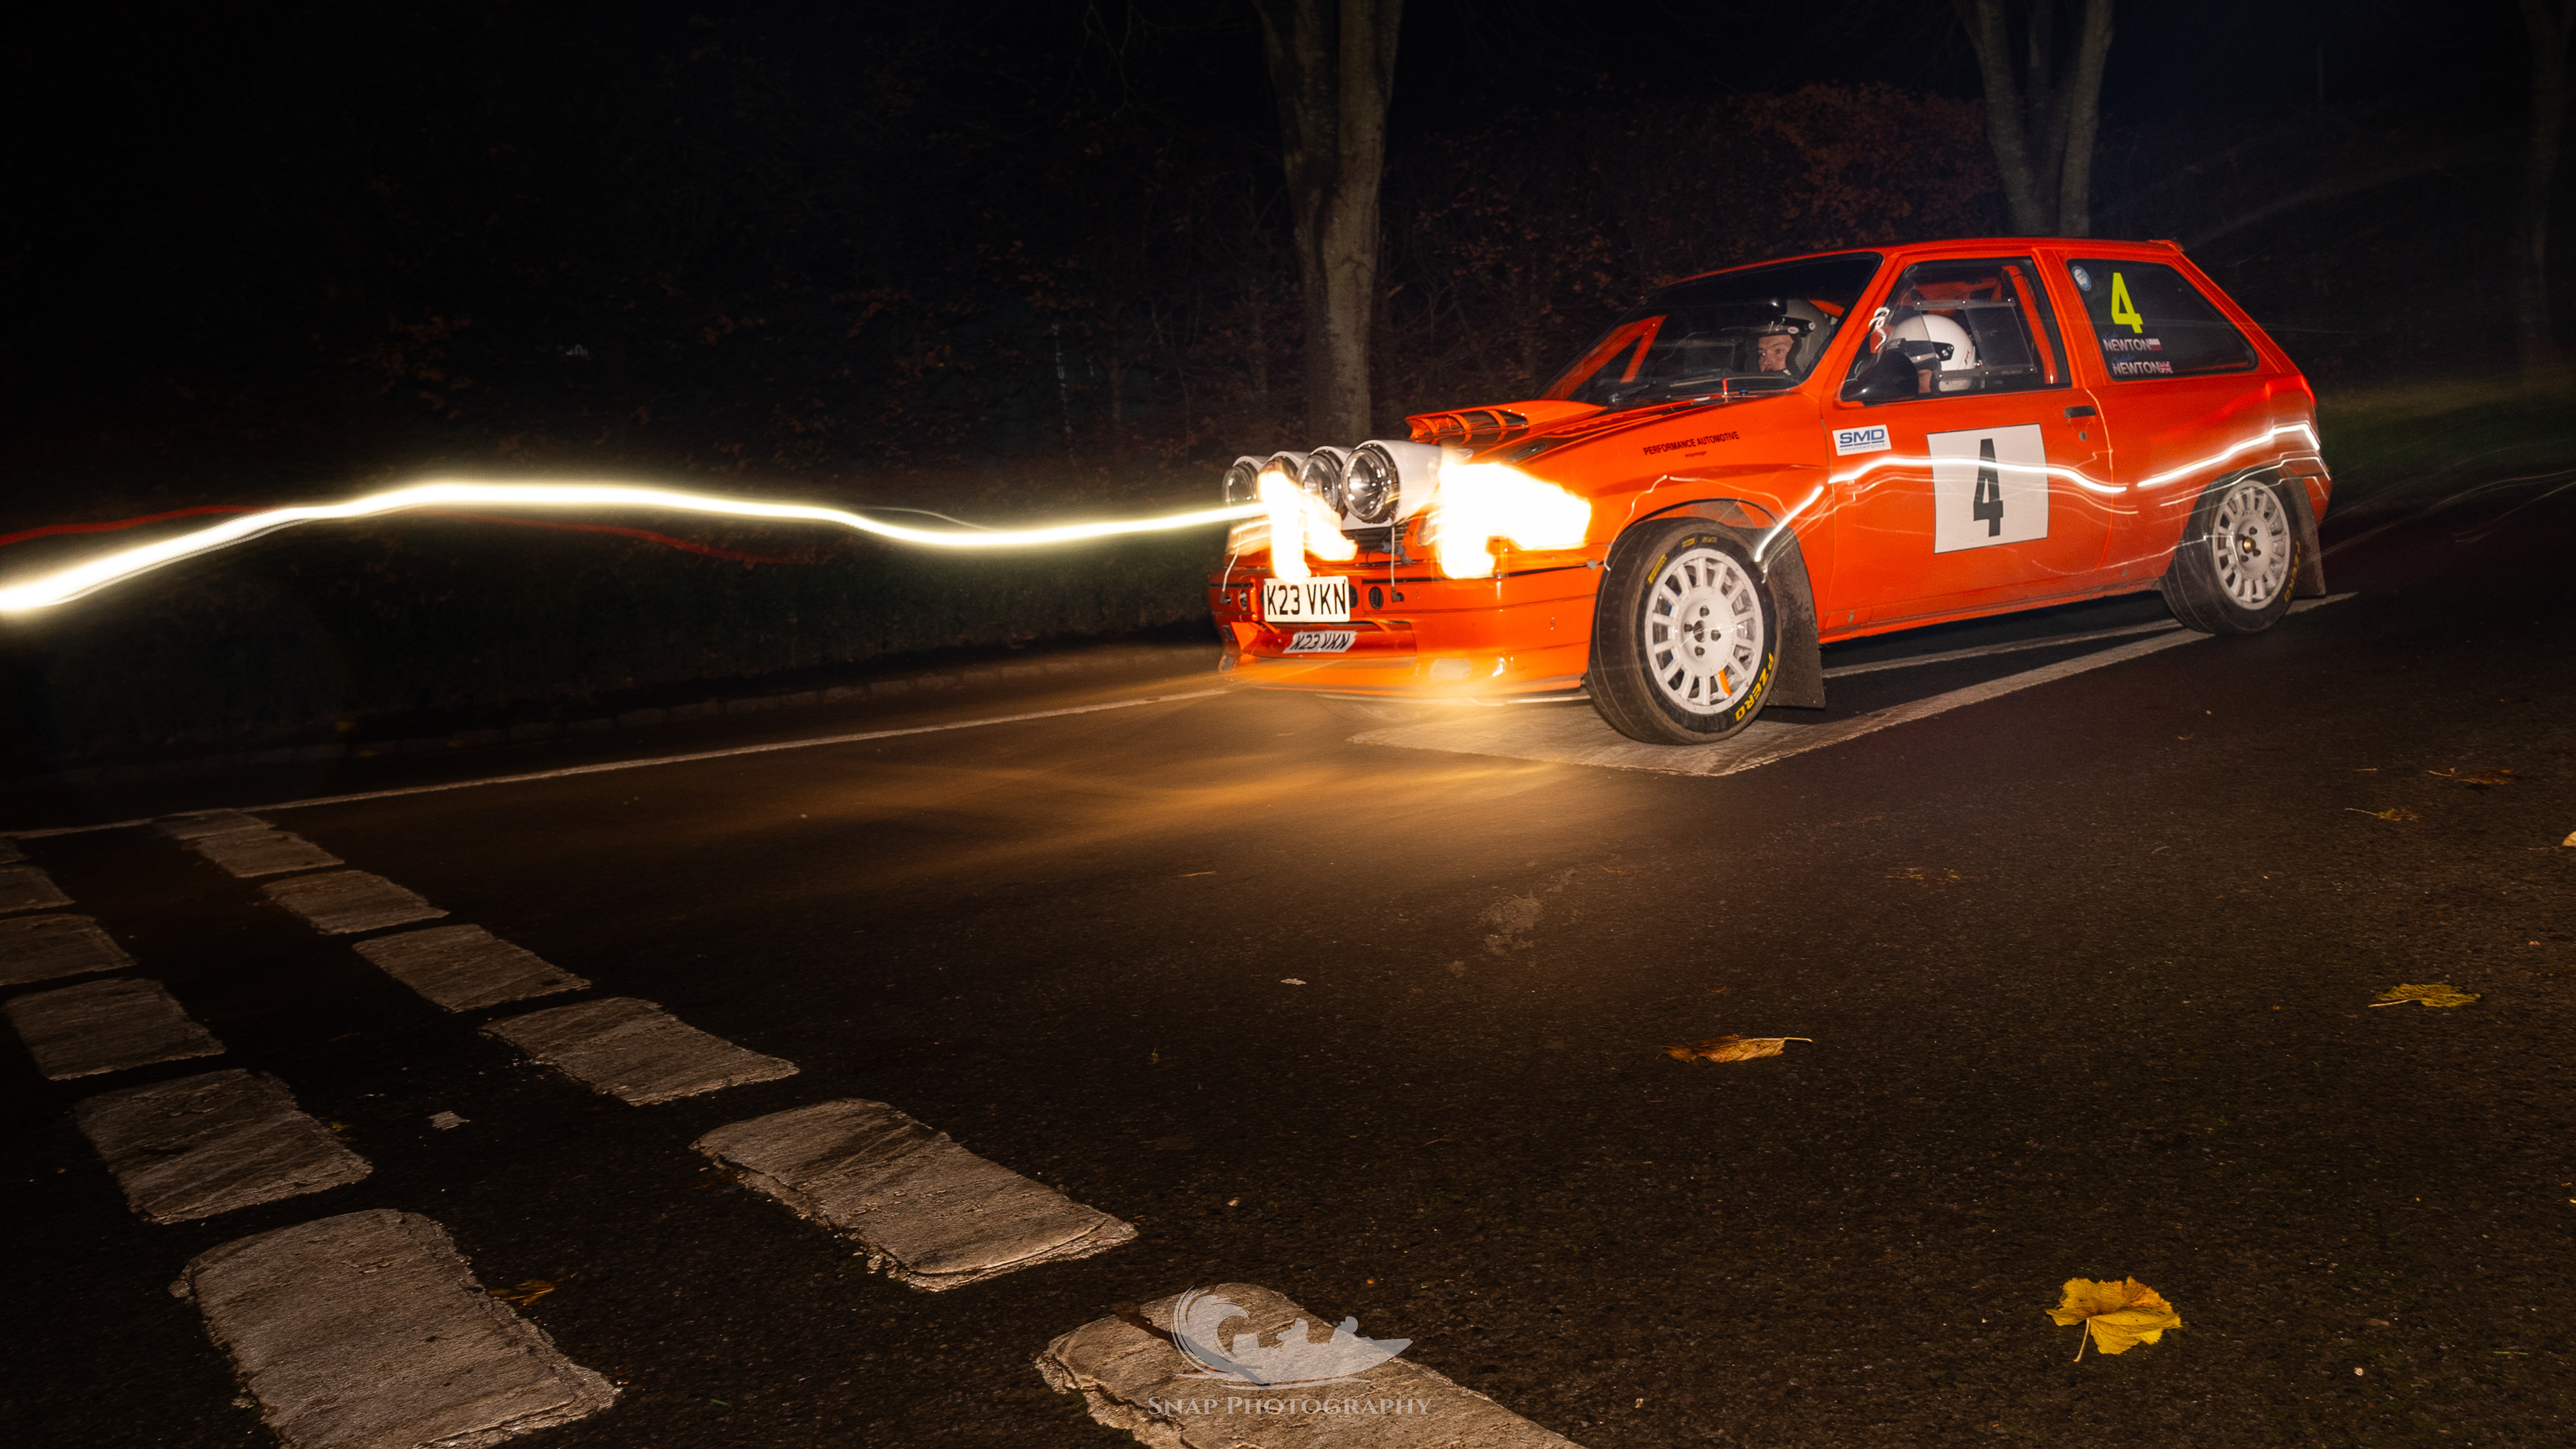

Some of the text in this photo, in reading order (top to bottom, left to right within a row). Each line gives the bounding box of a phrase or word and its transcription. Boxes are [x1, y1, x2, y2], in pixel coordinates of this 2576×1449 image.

[2111, 272, 2143, 333] 4
[2102, 338, 2151, 352] NEWTON
[2112, 361, 2161, 375] NEWTON
[1643, 439, 1697, 455] PERFORMANCE
[1697, 431, 1740, 445] AUTOMOTIVE
[1839, 429, 1885, 444] SMD
[1973, 438, 2004, 537] 4
[1267, 584, 1346, 615] K23 VKN
[1289, 633, 1350, 650] K23 VKN
